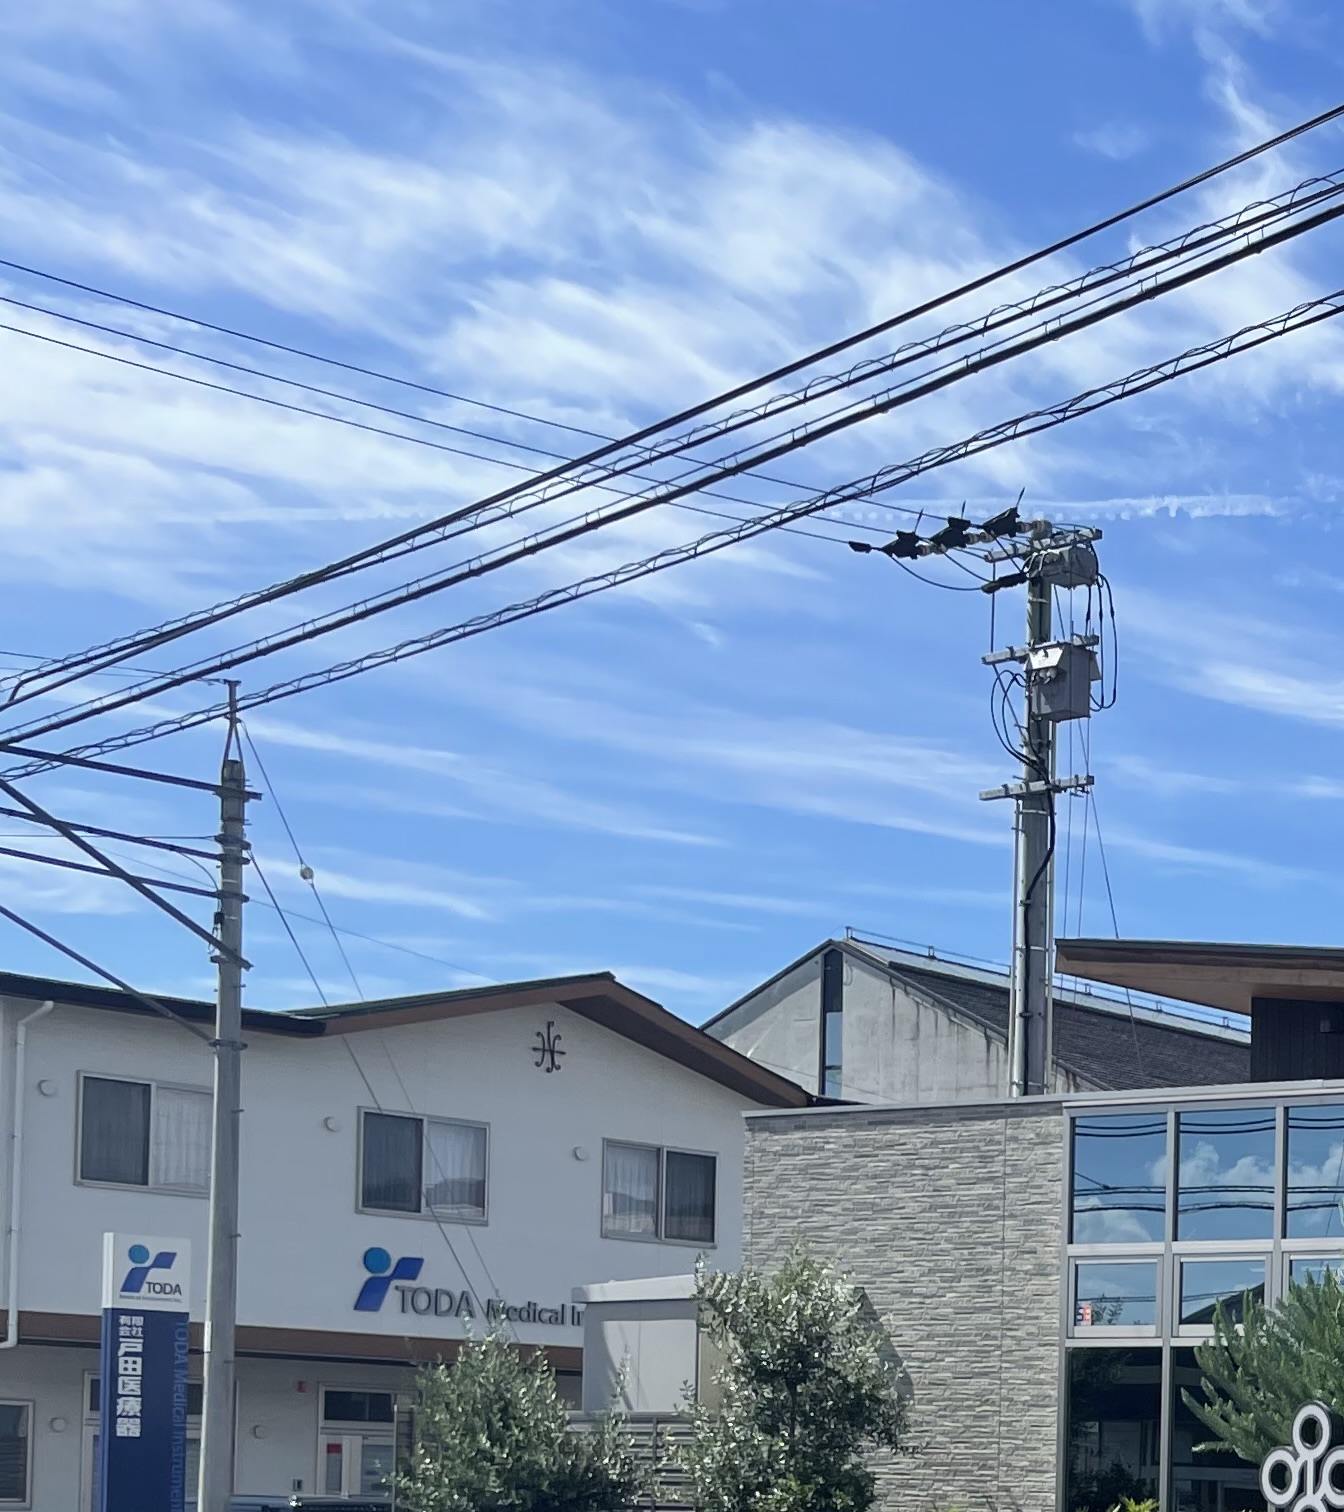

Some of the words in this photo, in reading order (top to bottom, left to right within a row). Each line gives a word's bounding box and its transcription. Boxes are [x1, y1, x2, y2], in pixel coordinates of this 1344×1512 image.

[146, 1281, 182, 1296] TODA
[395, 1285, 475, 1318] TODA
[486, 1298, 565, 1325] Medical
[173, 1319, 189, 1364] TODA
